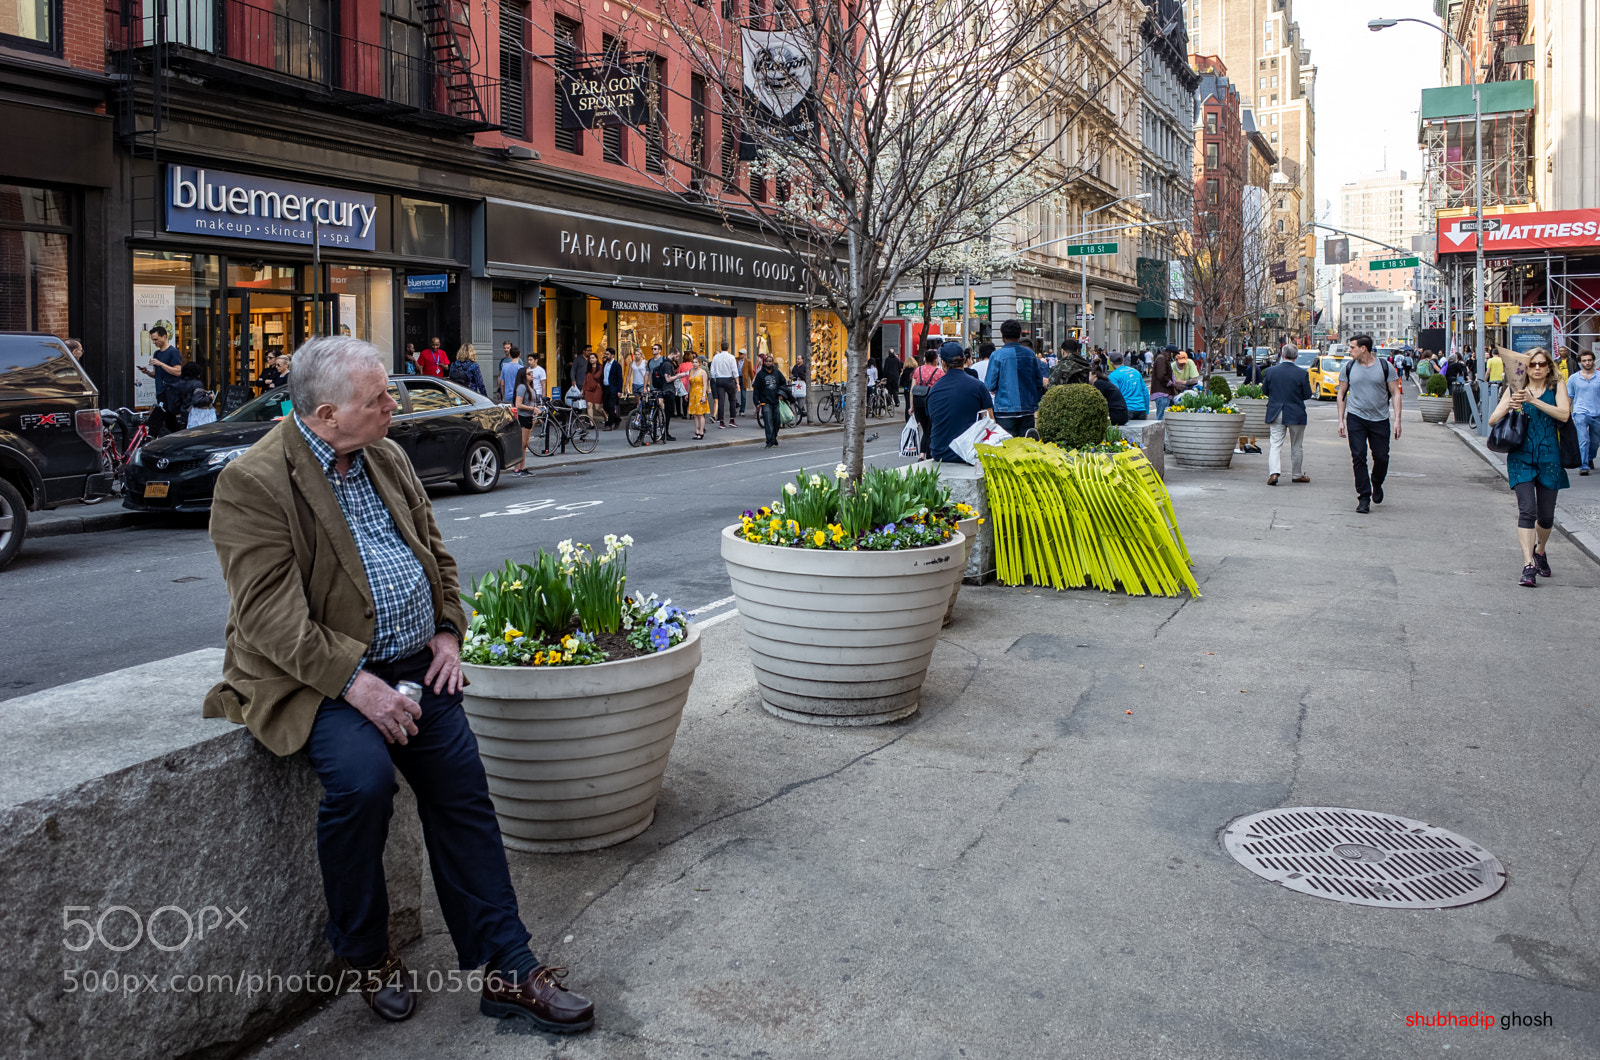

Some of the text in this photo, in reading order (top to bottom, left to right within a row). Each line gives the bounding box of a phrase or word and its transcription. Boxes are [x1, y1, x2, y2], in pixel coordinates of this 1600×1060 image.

[571, 76, 640, 96] PARAGON
[579, 93, 634, 111] SPORTS
[173, 166, 377, 238] bluemercury
[195, 218, 350, 244] makeup skincar spa
[561, 231, 651, 264] PARAGON
[662, 246, 744, 276] SPORTING
[752, 260, 796, 282] GOODS
[1097, 245, 1105, 253] St
[407, 278, 446, 287] bluemercury
[612, 301, 659, 312] PARAGON SPORTS
